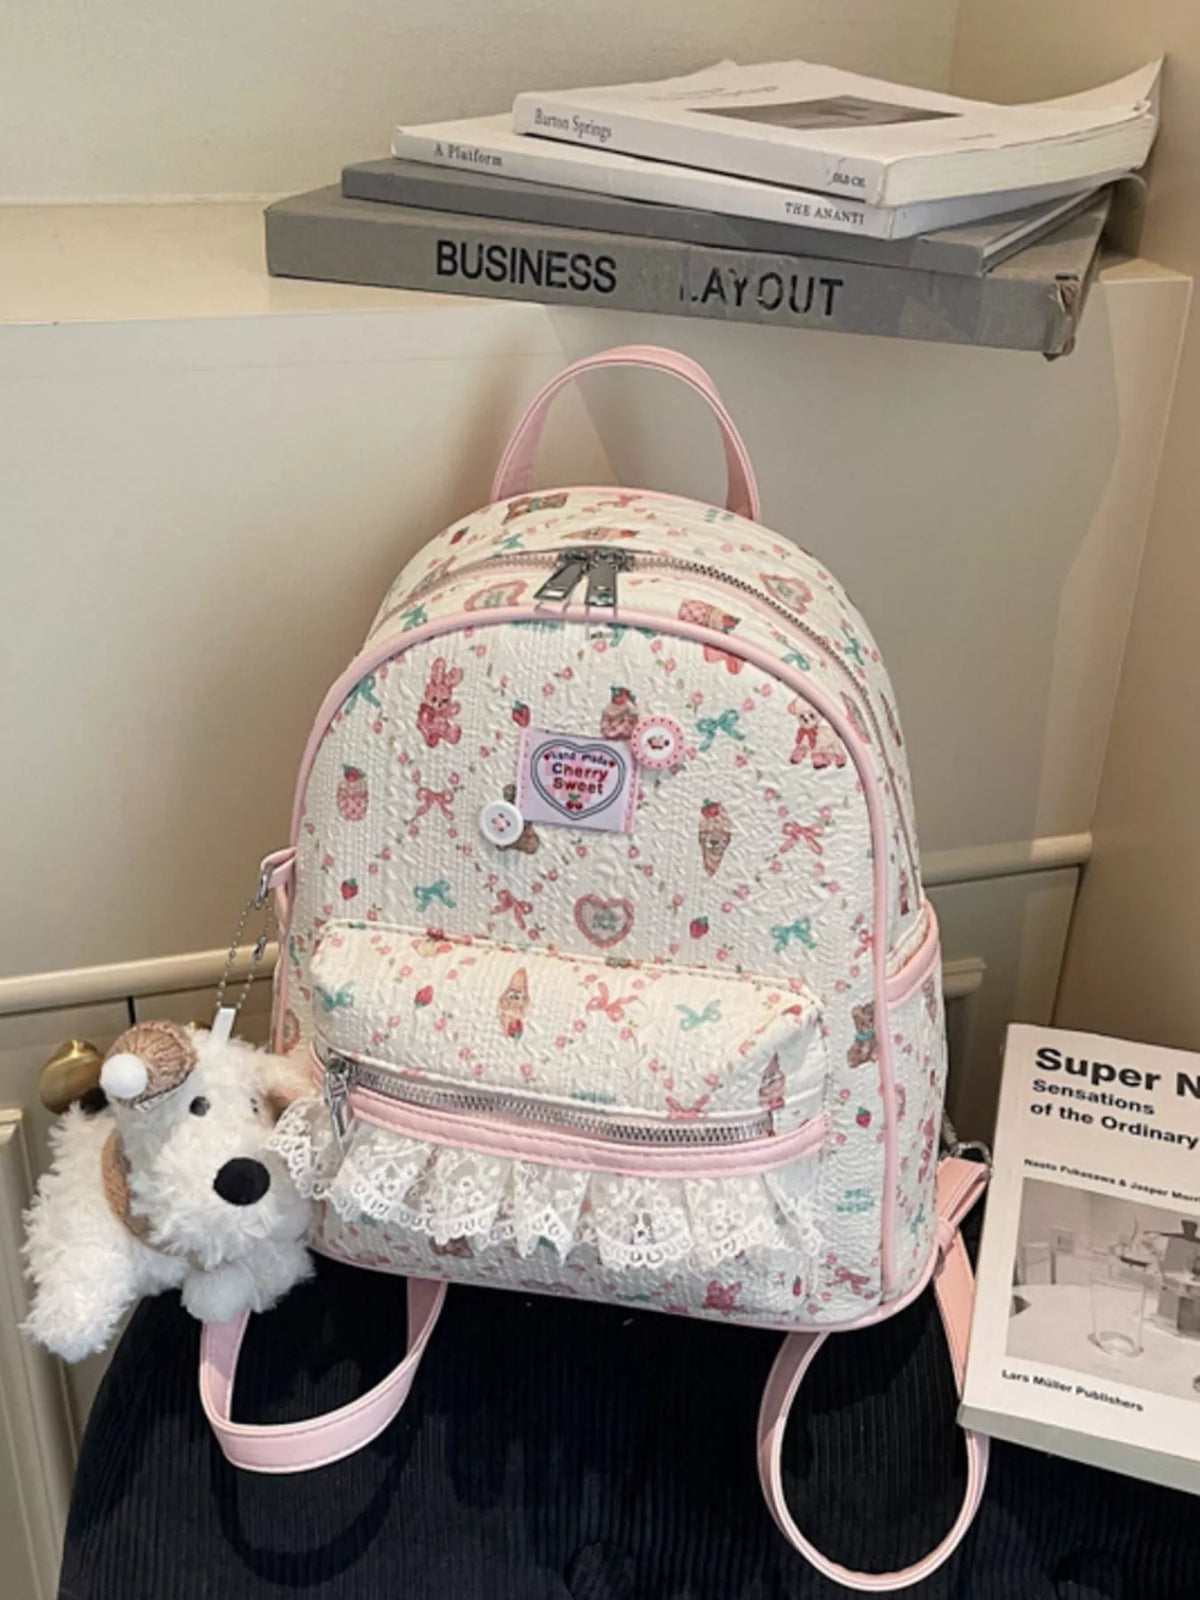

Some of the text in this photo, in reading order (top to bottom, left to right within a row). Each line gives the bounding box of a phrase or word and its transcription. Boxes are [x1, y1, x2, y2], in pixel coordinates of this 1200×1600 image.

[572, 114, 612, 143] Springs
[433, 142, 503, 167] A Platform
[785, 201, 865, 226] THE ANANTI
[436, 239, 617, 294] BUSINESS
[552, 762, 609, 781] Cherry
[552, 777, 604, 795] Sweet
[1035, 1047, 1162, 1091] Super
[1032, 1079, 1155, 1116] Sensations
[1030, 1102, 1199, 1150] of the Ordinary
[1119, 1178, 1127, 1189] &
[1130, 1182, 1168, 1197] Jasper
[1001, 1369, 1144, 1412] Lars Müller Publishers
